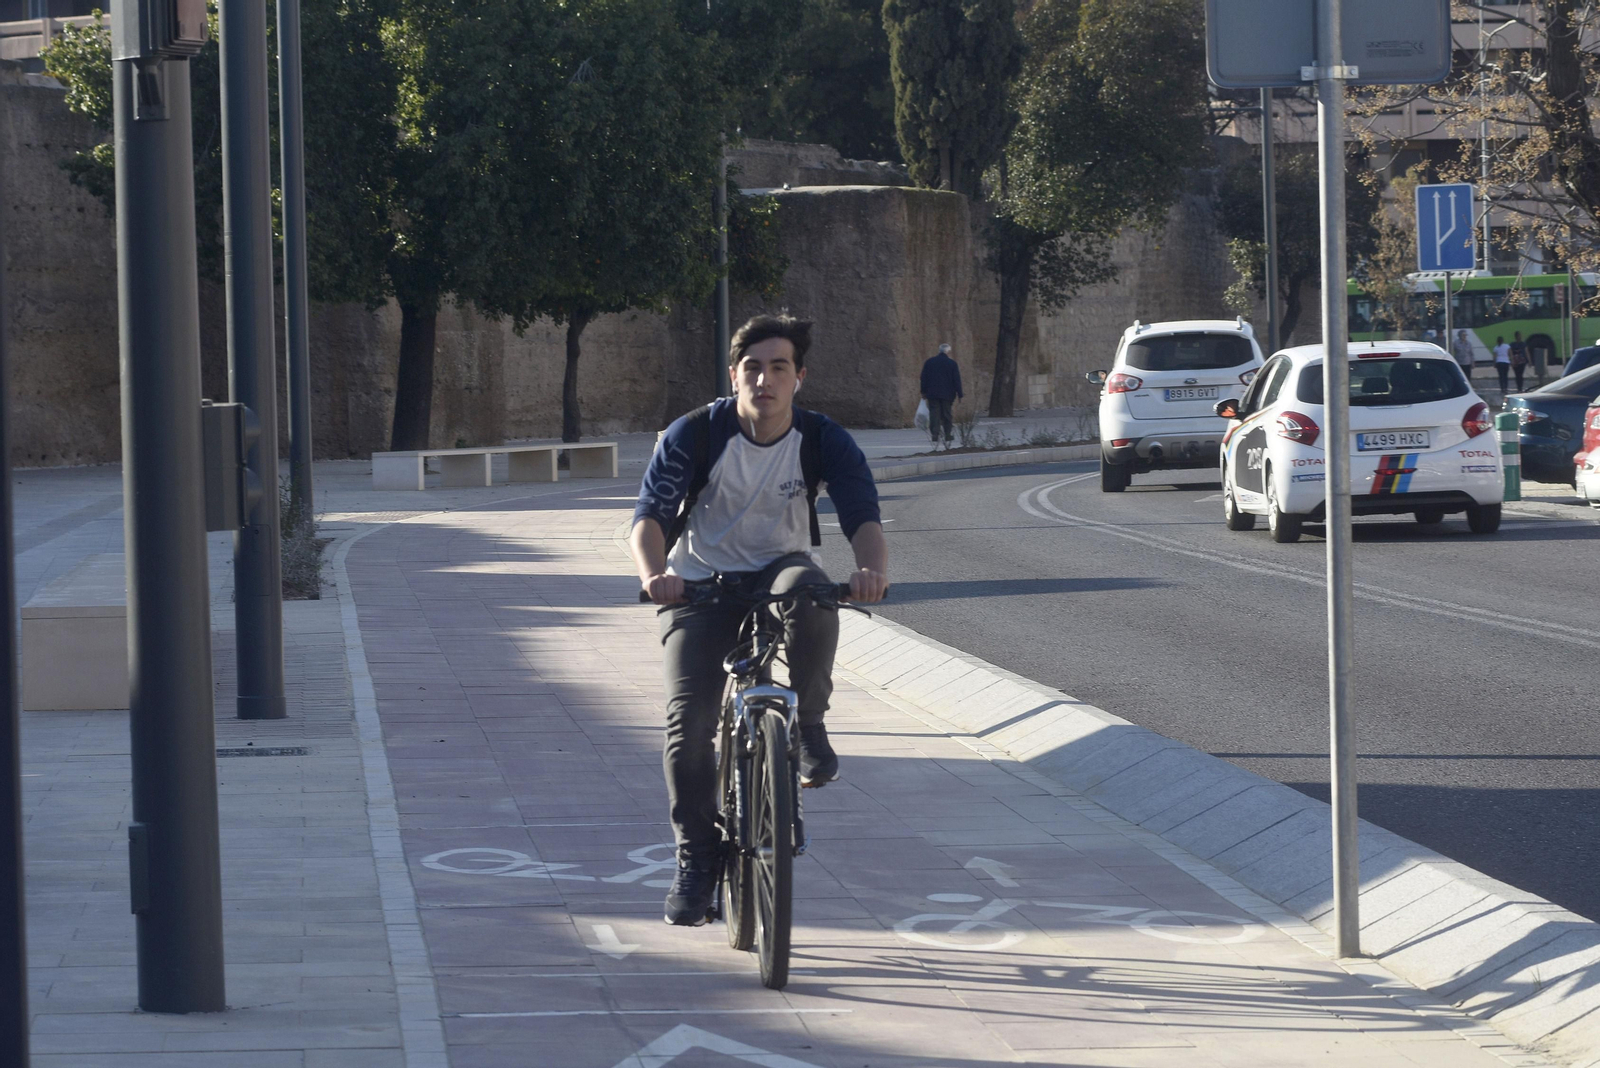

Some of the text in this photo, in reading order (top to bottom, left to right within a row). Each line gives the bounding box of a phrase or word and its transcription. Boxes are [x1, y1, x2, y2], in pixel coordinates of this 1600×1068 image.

[1170, 388, 1215, 399] 8915 GVT
[1364, 433, 1424, 446] 4499 HXC
[1458, 450, 1495, 458] TOTAL
[1291, 458, 1325, 468] TOTA
